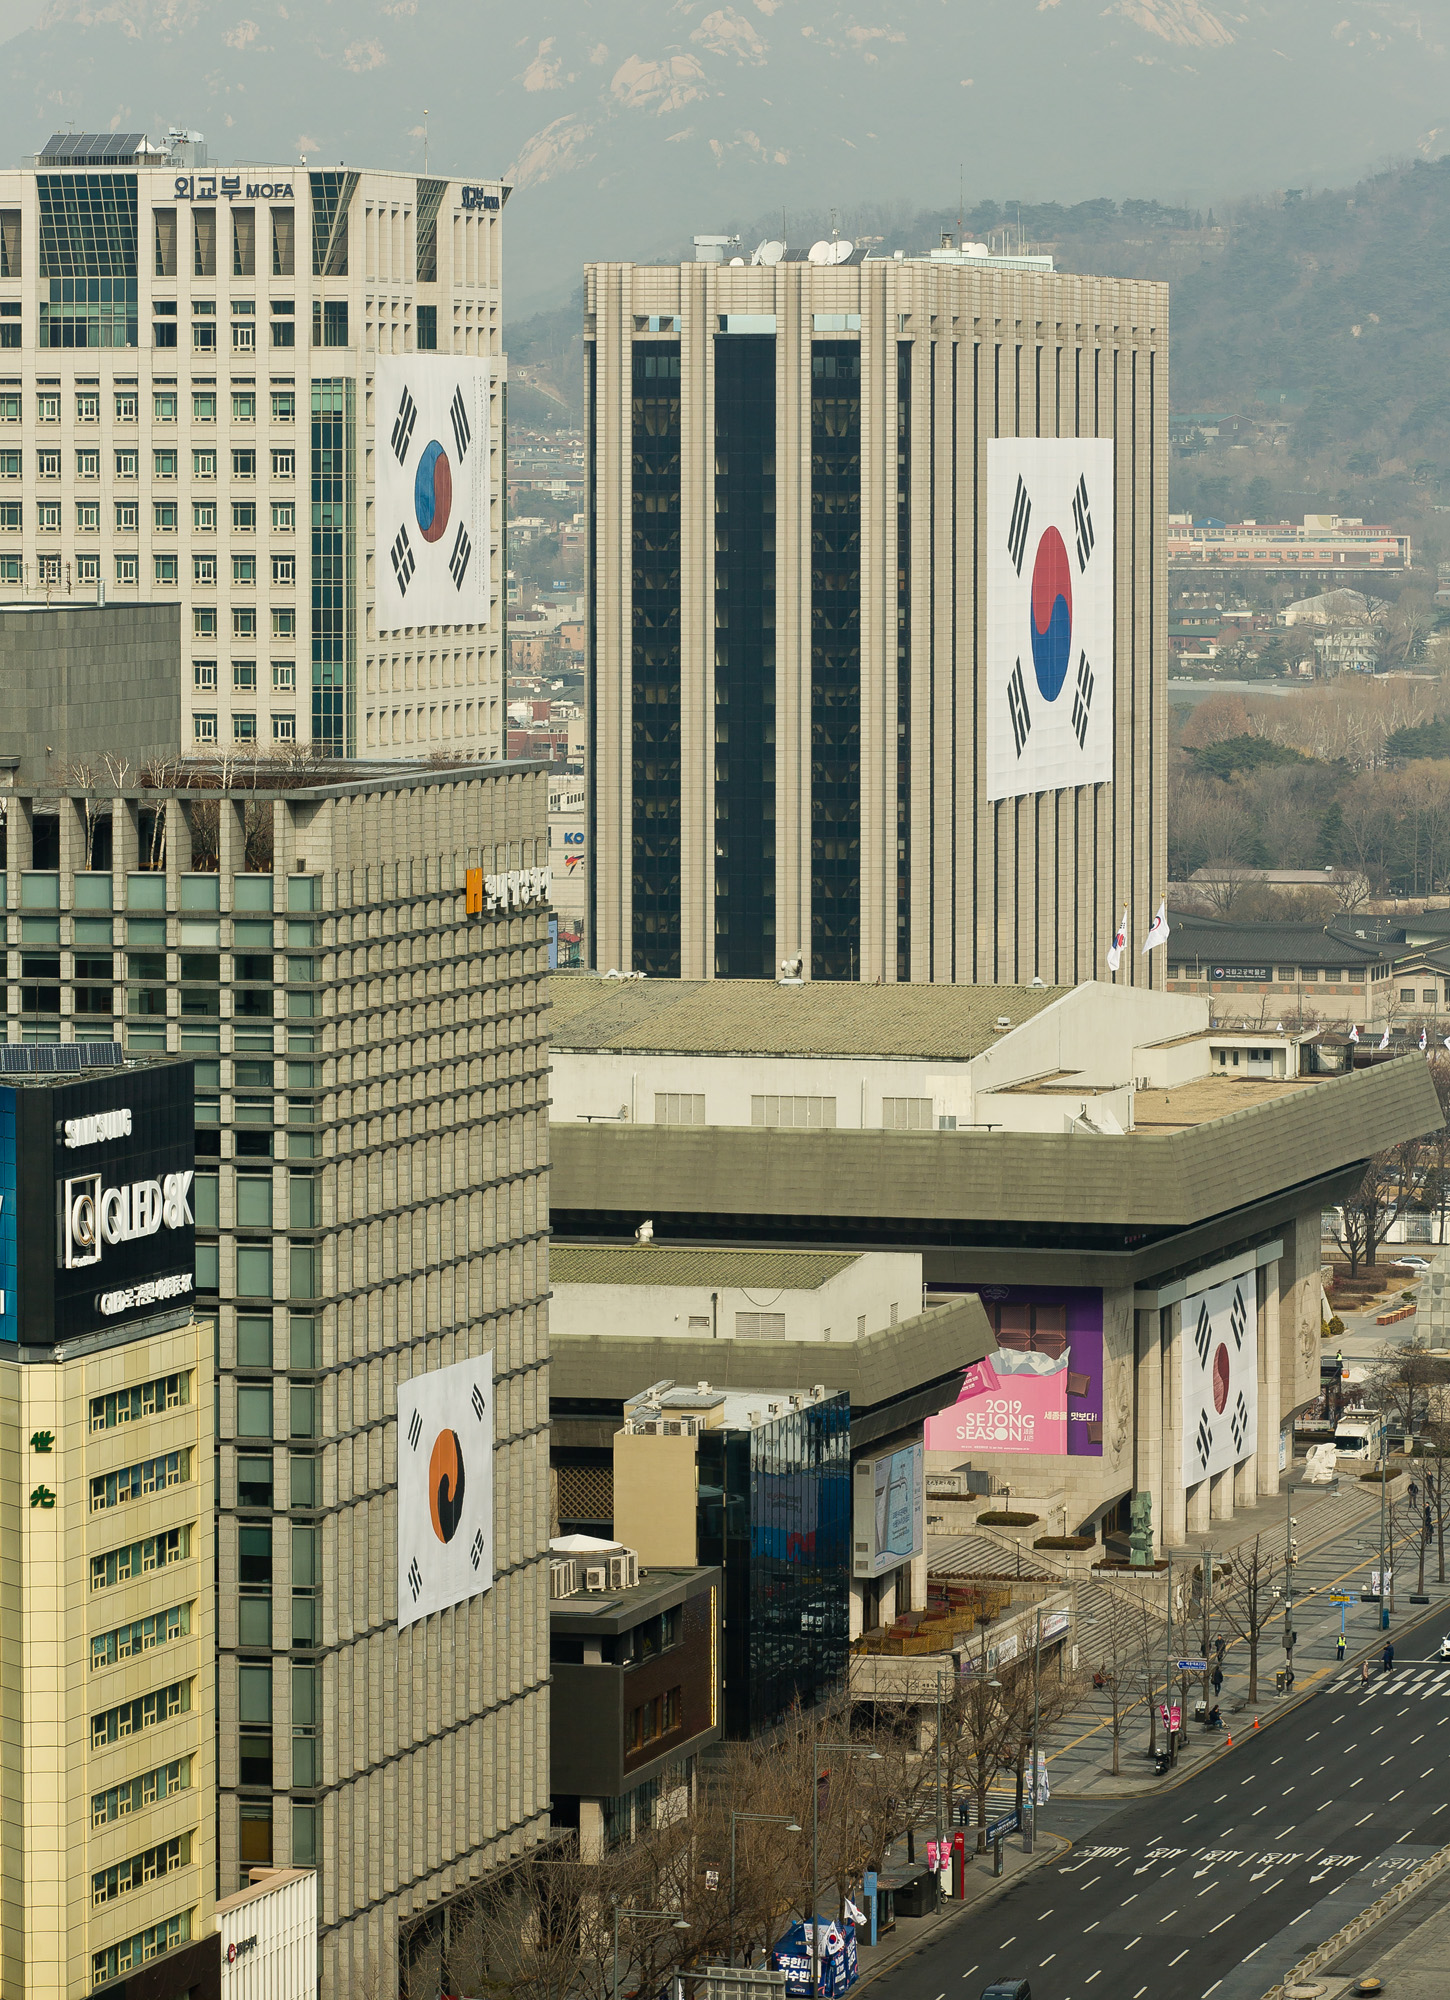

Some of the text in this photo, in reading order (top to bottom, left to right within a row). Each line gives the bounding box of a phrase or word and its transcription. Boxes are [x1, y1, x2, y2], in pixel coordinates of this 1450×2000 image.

[174, 175, 295, 201] 외교부 MOFA
[64, 1108, 132, 1149] SAMSUNG
[101, 1180, 163, 1245] QLED
[163, 1170, 195, 1230] 8K
[985, 1399, 1023, 1415] 2019
[966, 1413, 1035, 1428] SEJONG
[1043, 1411, 1098, 1421] 세종을 맛보다!
[956, 1426, 1022, 1442] SEASON
